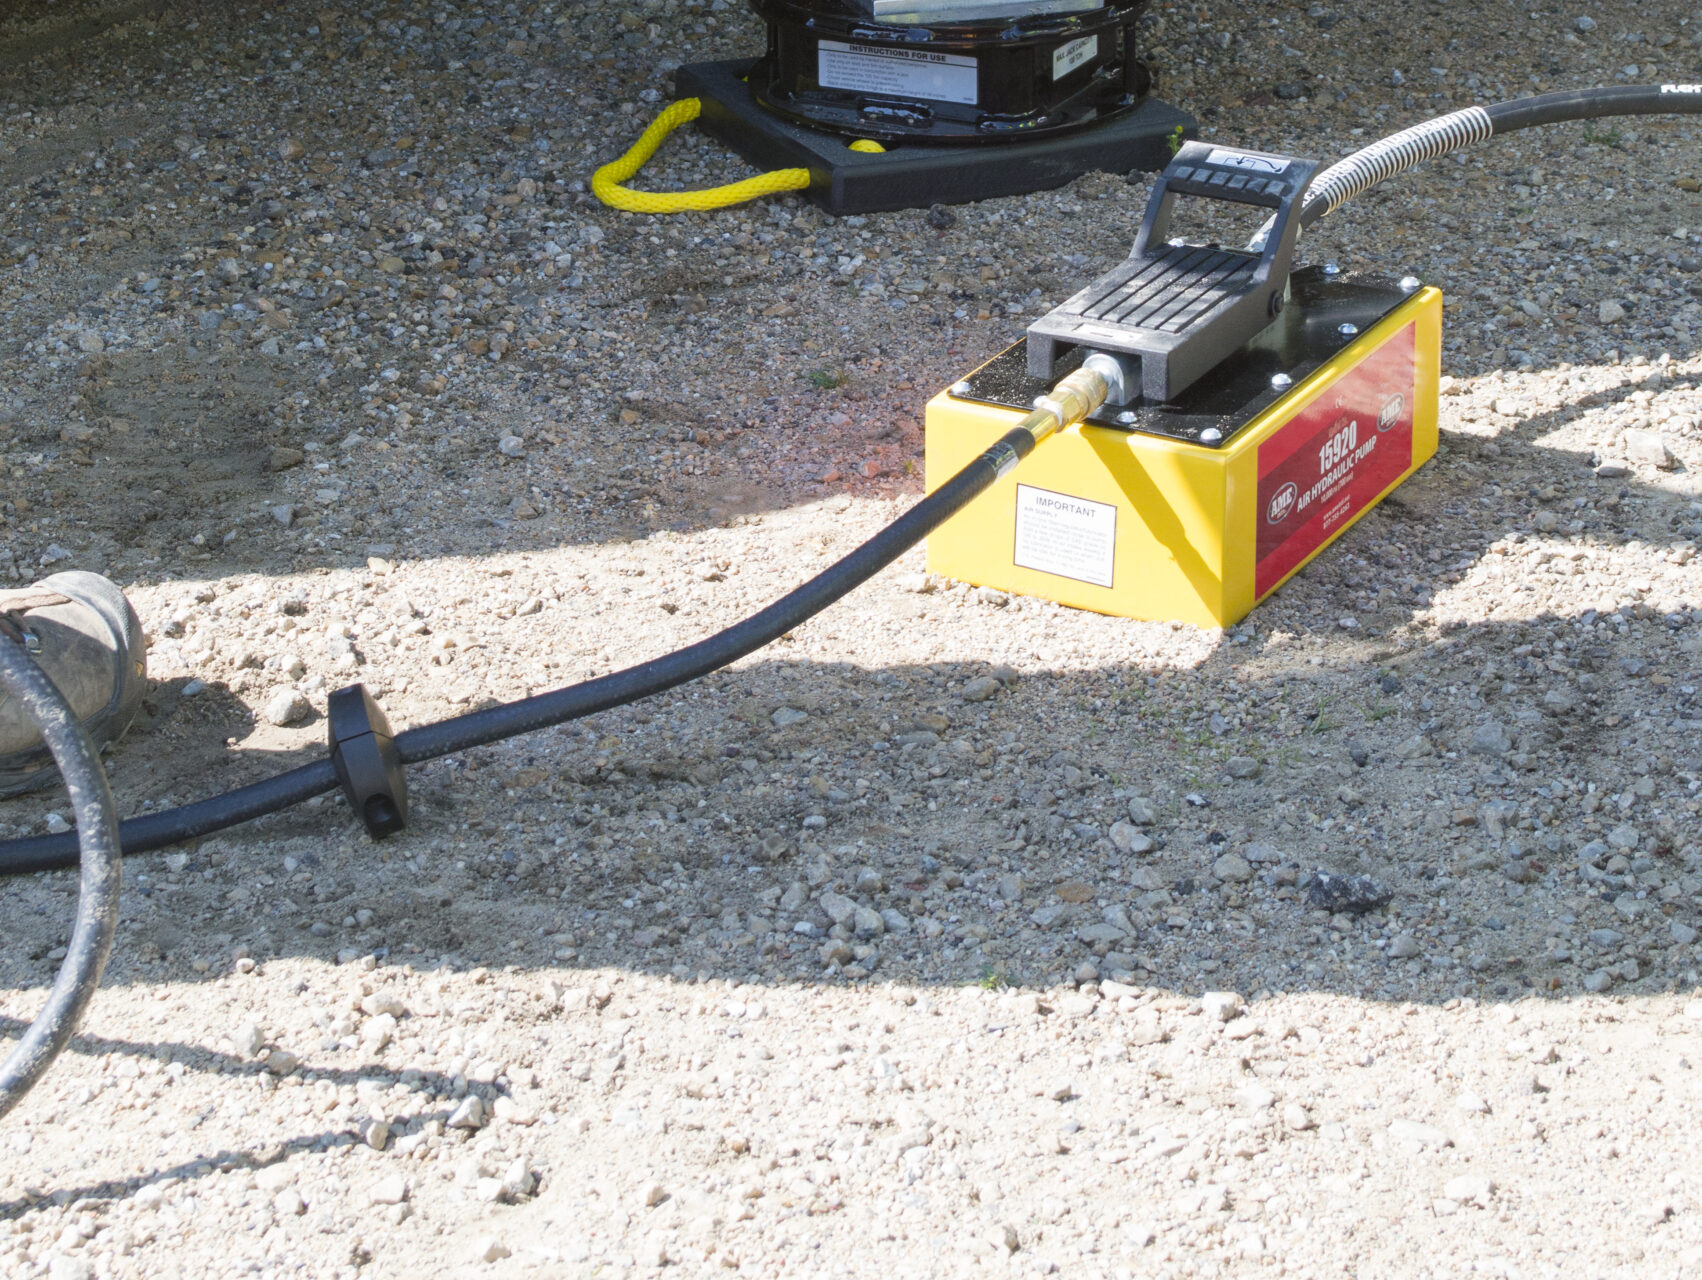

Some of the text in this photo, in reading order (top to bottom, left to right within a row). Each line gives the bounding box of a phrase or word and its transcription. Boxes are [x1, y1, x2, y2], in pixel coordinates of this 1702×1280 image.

[849, 45, 909, 58] INSTRUCTIONS
[911, 51, 928, 60] FOR
[930, 54, 946, 62] USE
[1381, 397, 1401, 426] AME
[1319, 420, 1357, 474] 15920
[1297, 491, 1311, 513] AIR
[1311, 454, 1355, 502] HYDRAULIC
[1355, 435, 1377, 464] PUMP
[1036, 496, 1096, 517] IMPORTANT
[1271, 486, 1294, 518] AME
